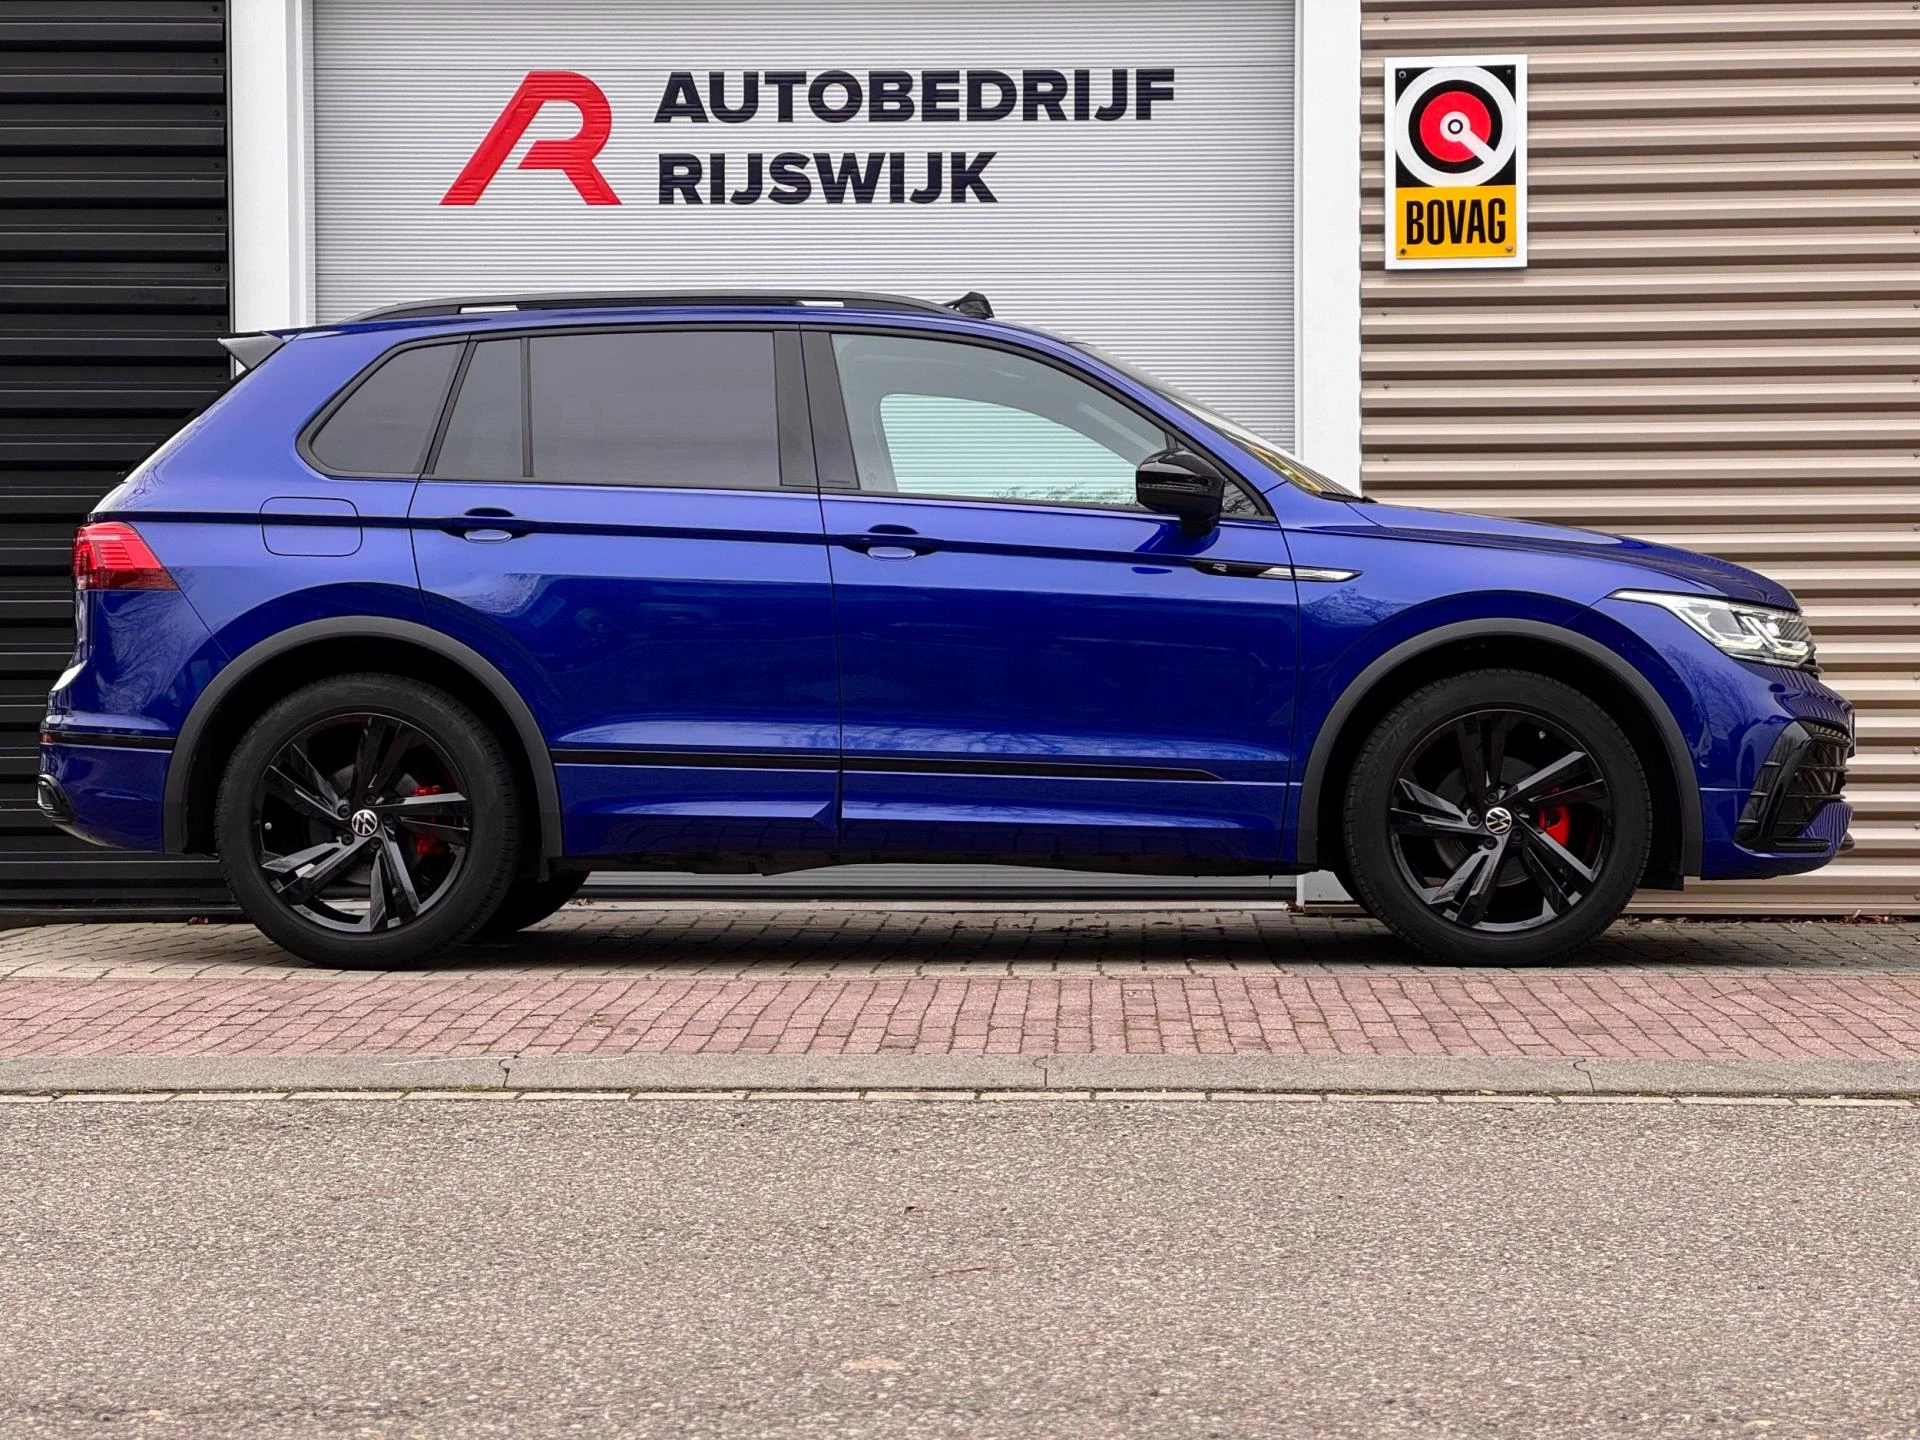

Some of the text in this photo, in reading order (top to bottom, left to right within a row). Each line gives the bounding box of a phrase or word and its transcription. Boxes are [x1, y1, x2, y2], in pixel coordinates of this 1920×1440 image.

[654, 69, 1174, 123] AUTOBEDRIJF
[658, 151, 998, 205] RIJSWIJK
[1405, 197, 1506, 246] BOVAG
